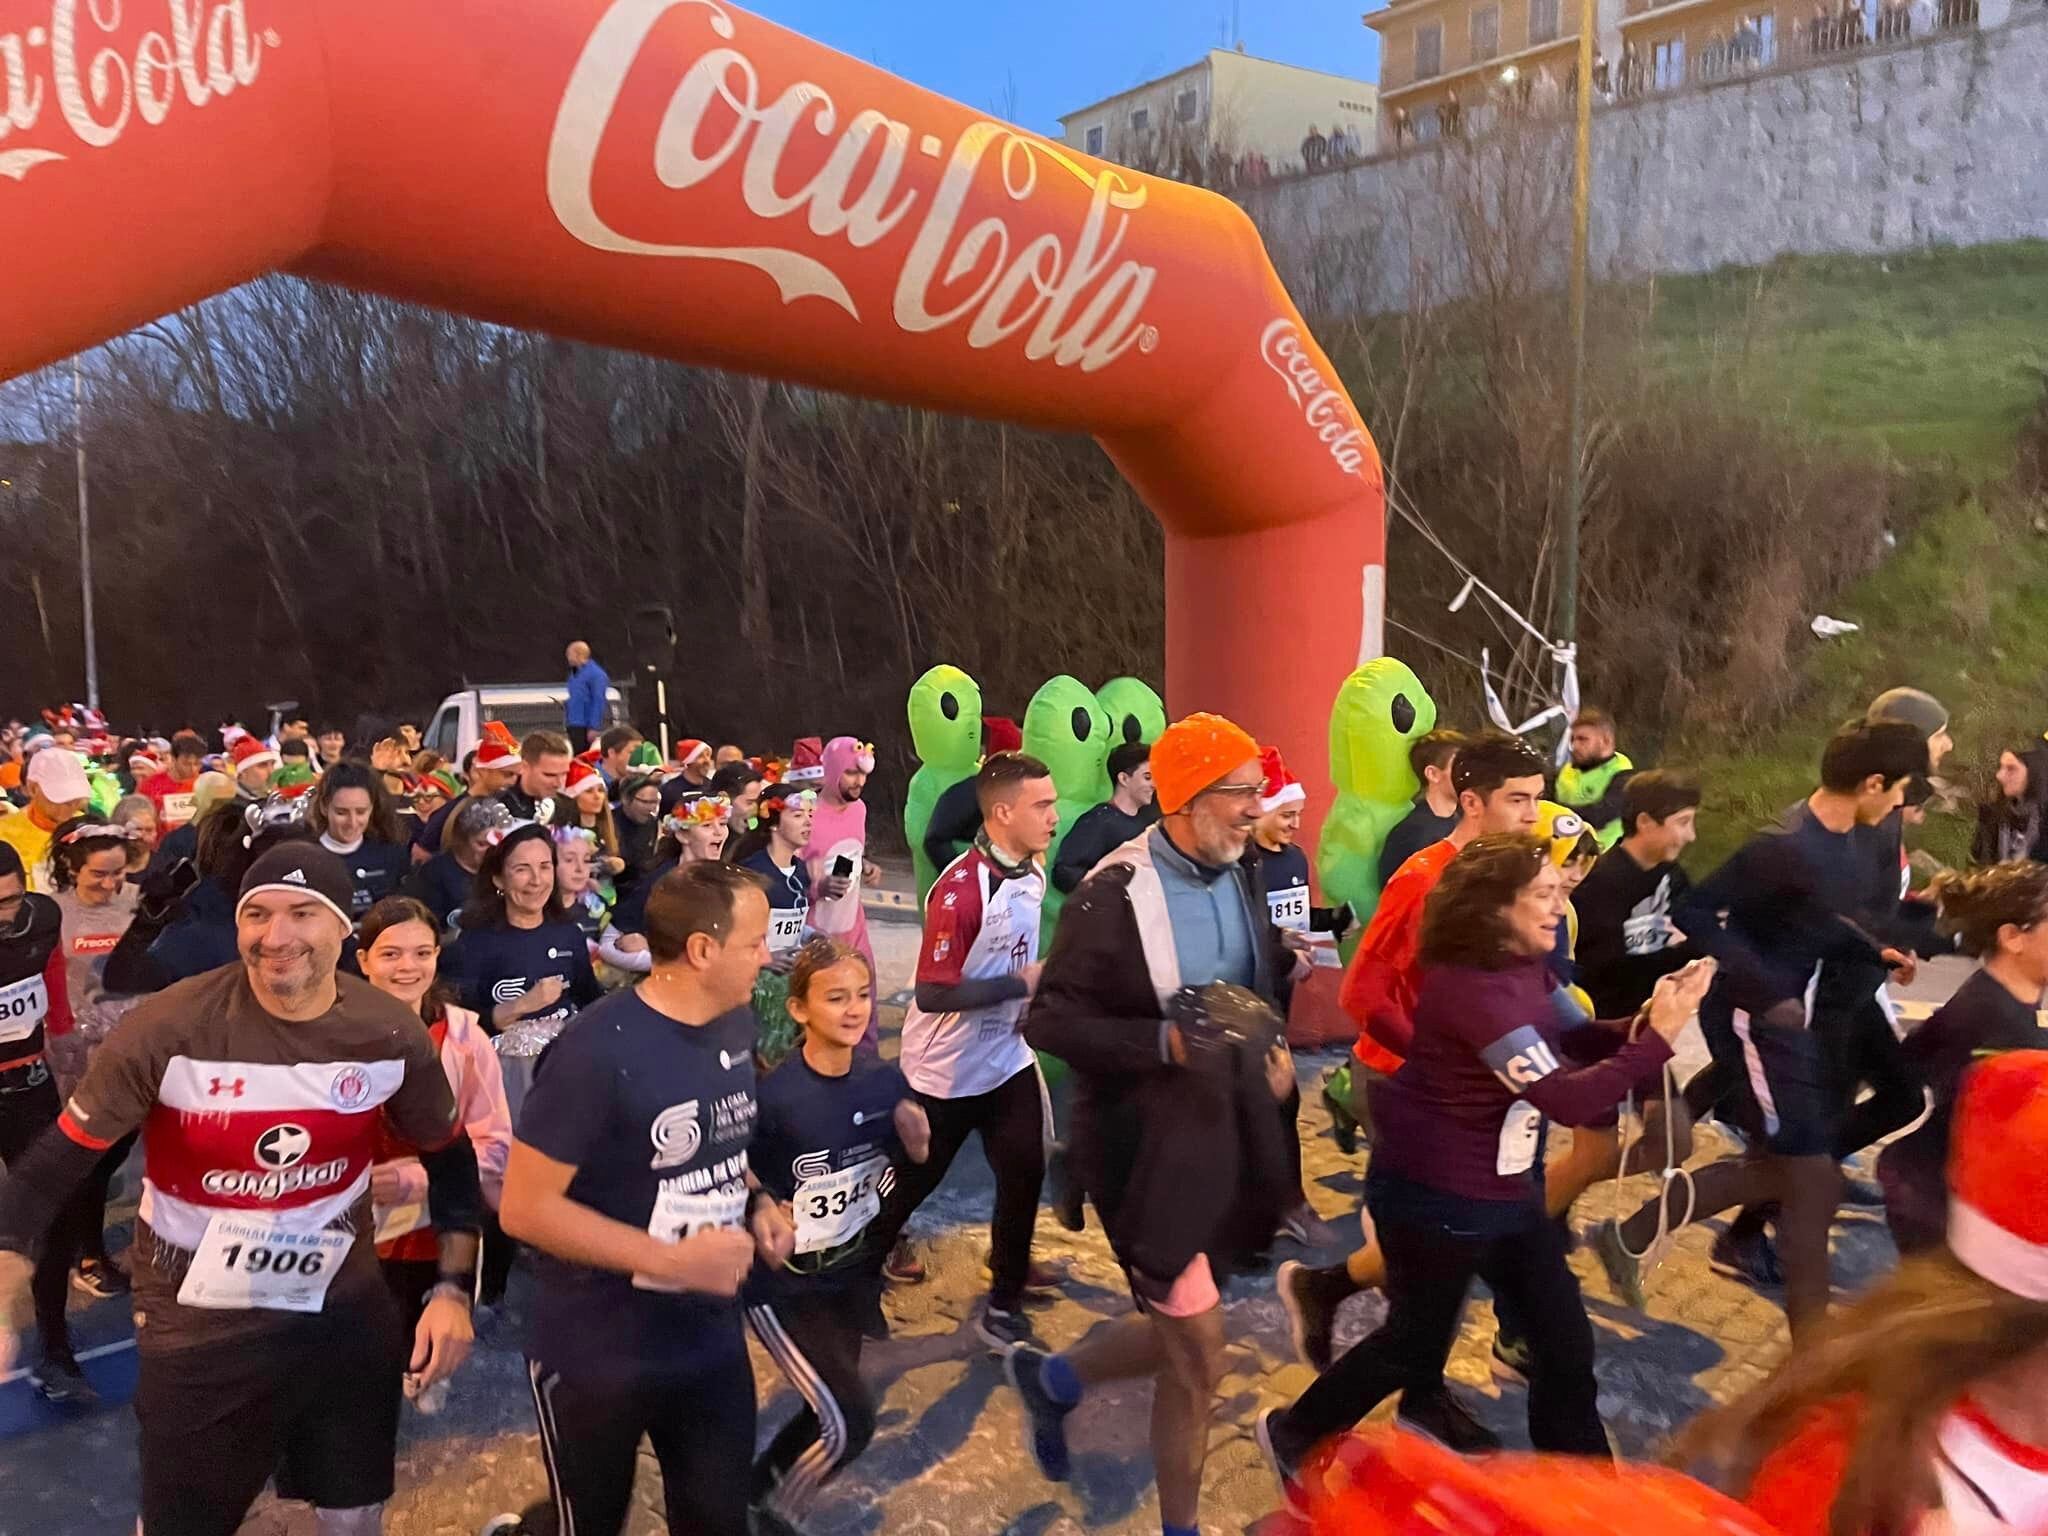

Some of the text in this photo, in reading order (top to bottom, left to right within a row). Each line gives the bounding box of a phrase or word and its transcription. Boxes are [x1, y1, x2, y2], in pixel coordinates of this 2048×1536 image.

[546, 0, 1152, 372] Coca-Cola
[1260, 317, 1365, 477] Coca-Cola
[202, 1157, 349, 1200] congstar
[221, 1241, 325, 1276] 1906
